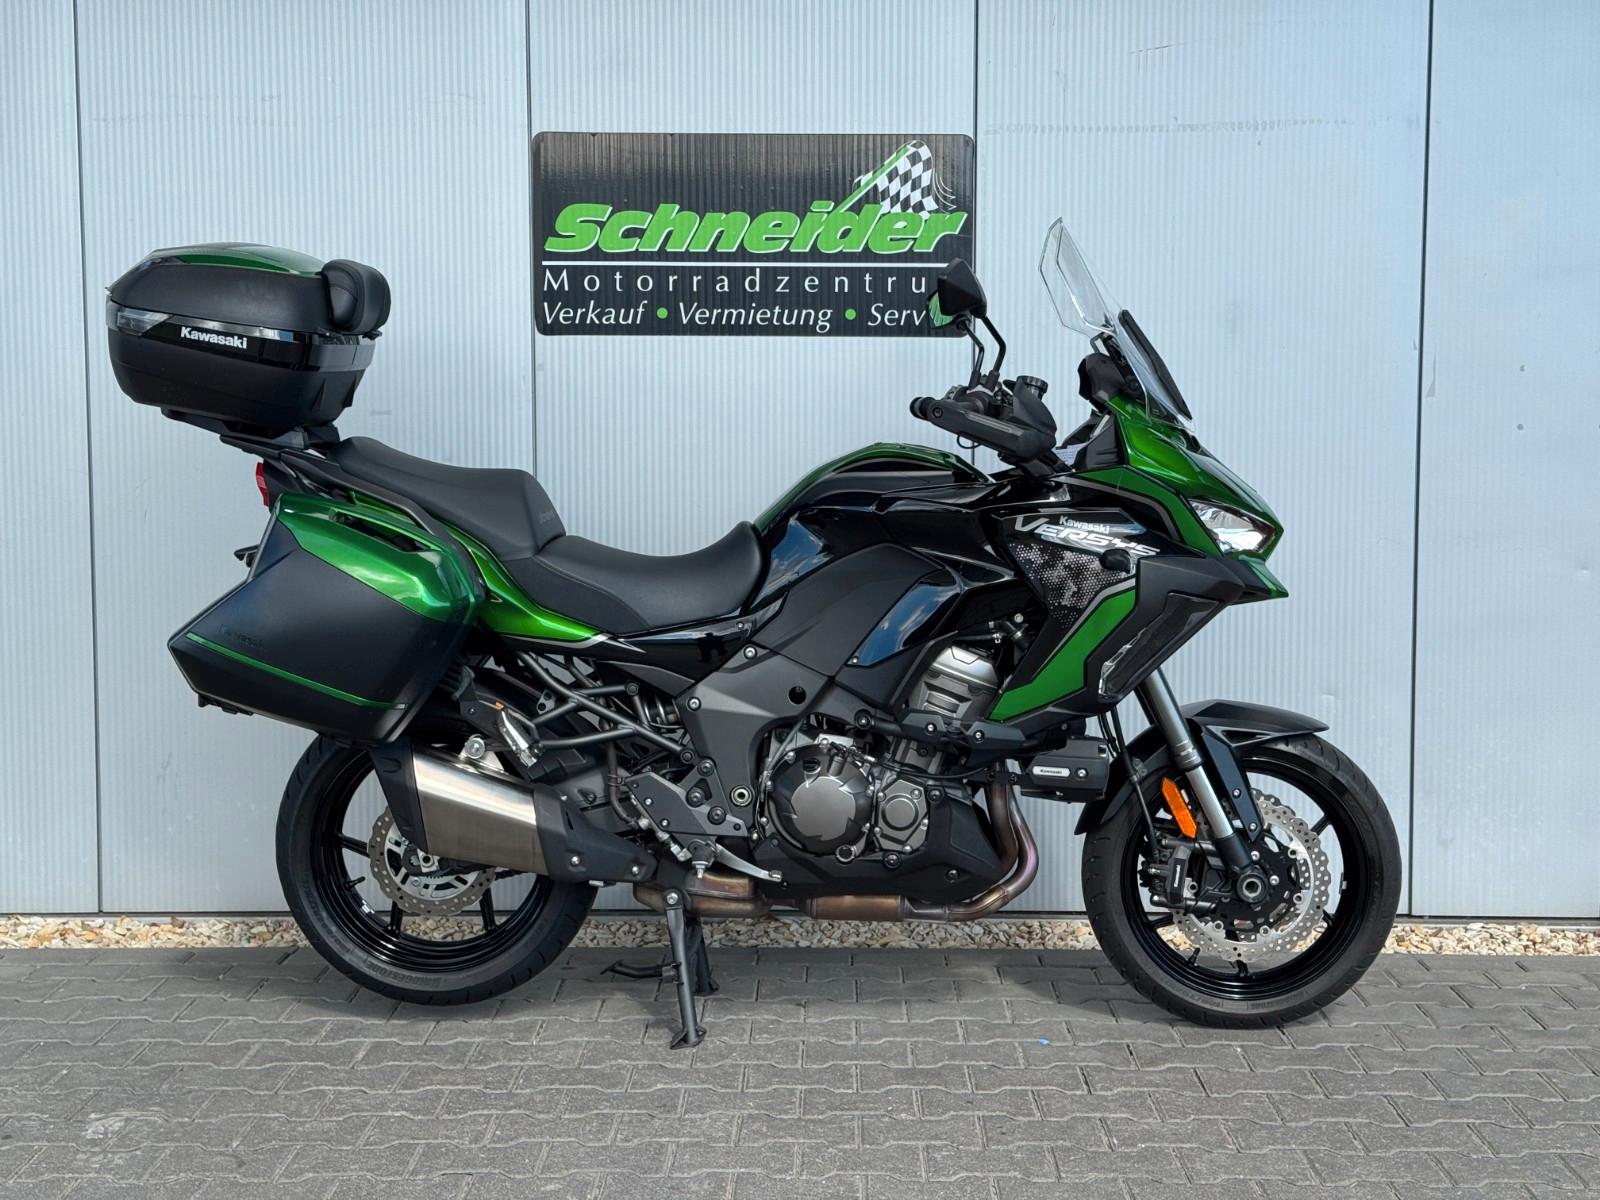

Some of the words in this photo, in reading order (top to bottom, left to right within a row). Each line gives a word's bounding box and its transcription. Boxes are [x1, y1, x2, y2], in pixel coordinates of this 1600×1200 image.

[544, 202, 968, 254] Schneider
[543, 268, 927, 293] Motorradzentru
[543, 300, 648, 325] Verkauf
[679, 302, 833, 333] Vermietung
[867, 303, 927, 326] Serv
[180, 326, 248, 349] Kawasaki
[1014, 515, 1161, 556] VERSYS
[1059, 515, 1111, 534] Kawasaki
